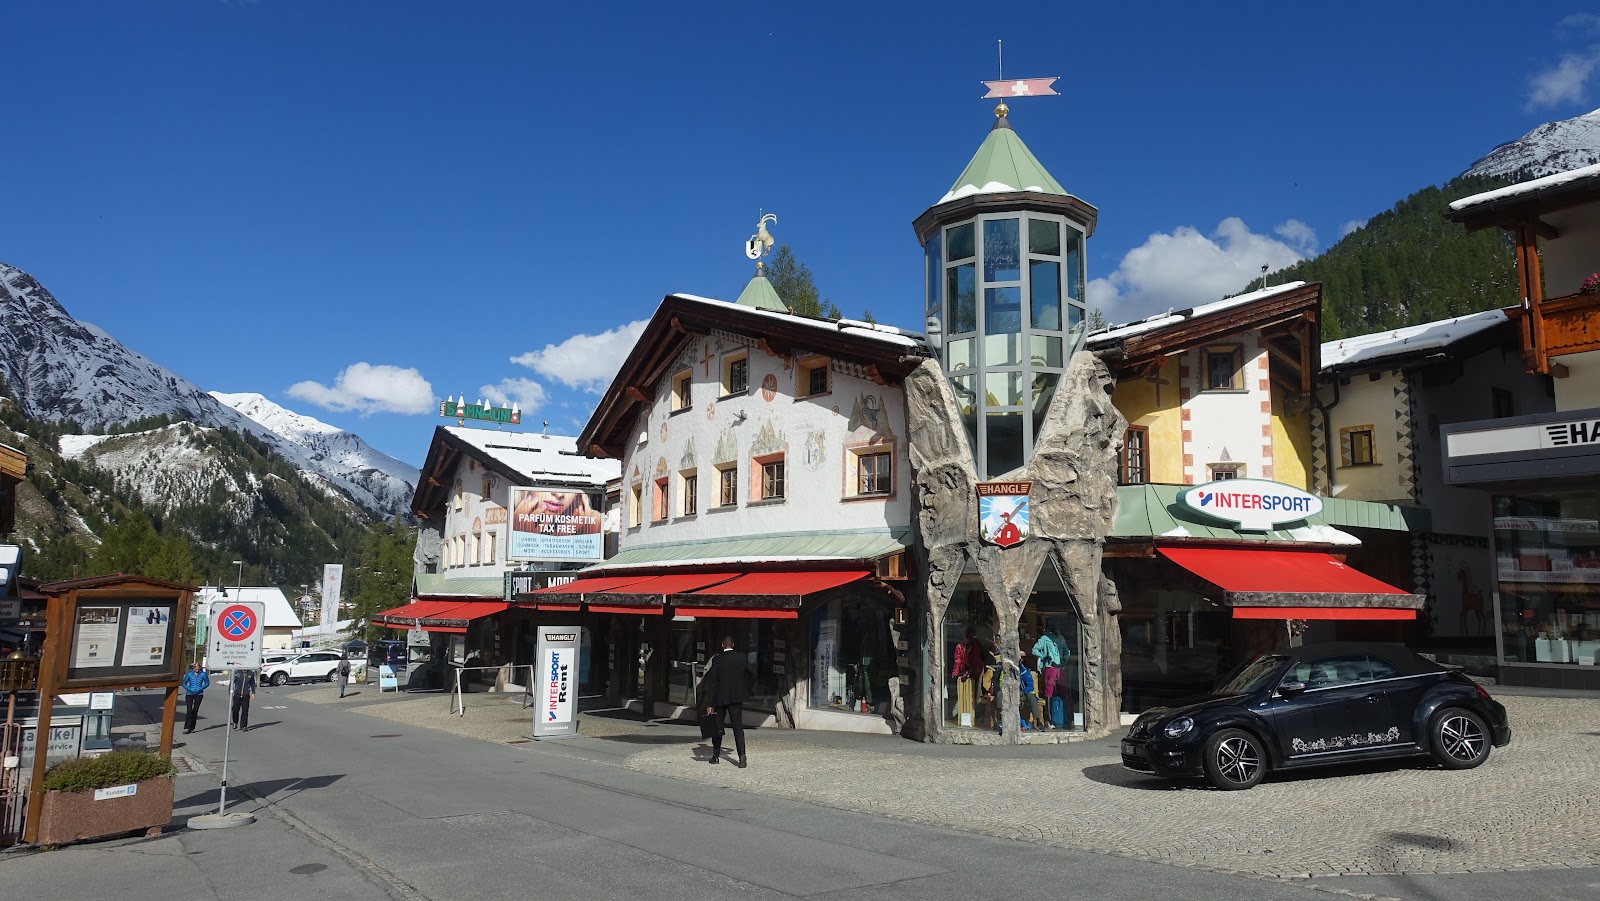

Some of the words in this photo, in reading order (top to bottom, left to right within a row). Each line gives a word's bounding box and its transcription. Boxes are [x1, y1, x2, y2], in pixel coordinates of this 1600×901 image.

[987, 484, 1021, 494] HANGL
[1215, 492, 1312, 512] INTERSPORT
[519, 513, 553, 523] PARFÜM
[555, 514, 596, 525] KOSMETIK
[539, 523, 555, 533] TAX
[557, 525, 577, 533] FREE
[512, 576, 532, 596] SPORT
[549, 651, 560, 710] INTERSPORT
[558, 664, 568, 703] Rent
